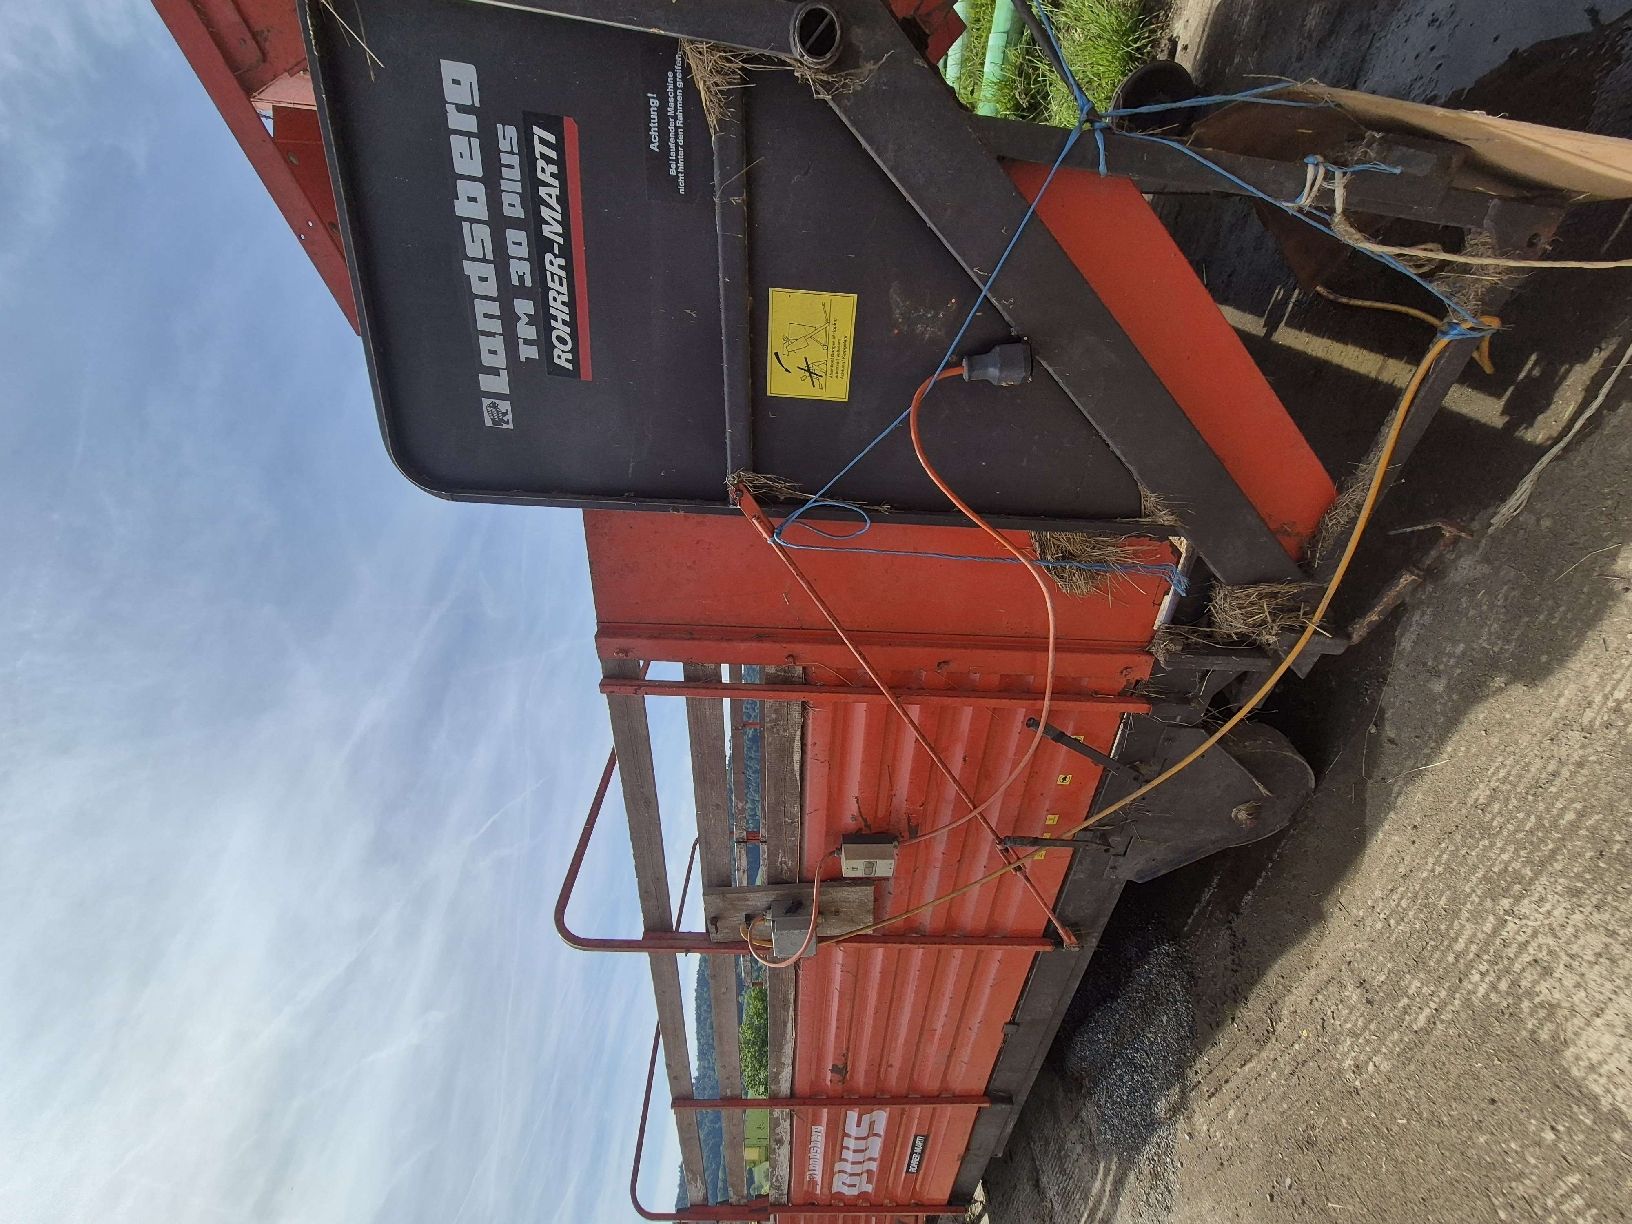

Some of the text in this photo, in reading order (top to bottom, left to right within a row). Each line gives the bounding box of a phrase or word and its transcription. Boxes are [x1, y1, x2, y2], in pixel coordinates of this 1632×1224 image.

[667, 72, 677, 176] Bei laufender Maschine
[676, 90, 684, 127] Rahmen
[676, 128, 684, 146] den
[677, 146, 685, 172] hinter
[677, 173, 685, 194] nicht
[440, 59, 510, 394] Landsberg
[532, 125, 574, 371] ROHRER-MARTI
[505, 228, 533, 287] 30
[513, 298, 540, 362] TM
